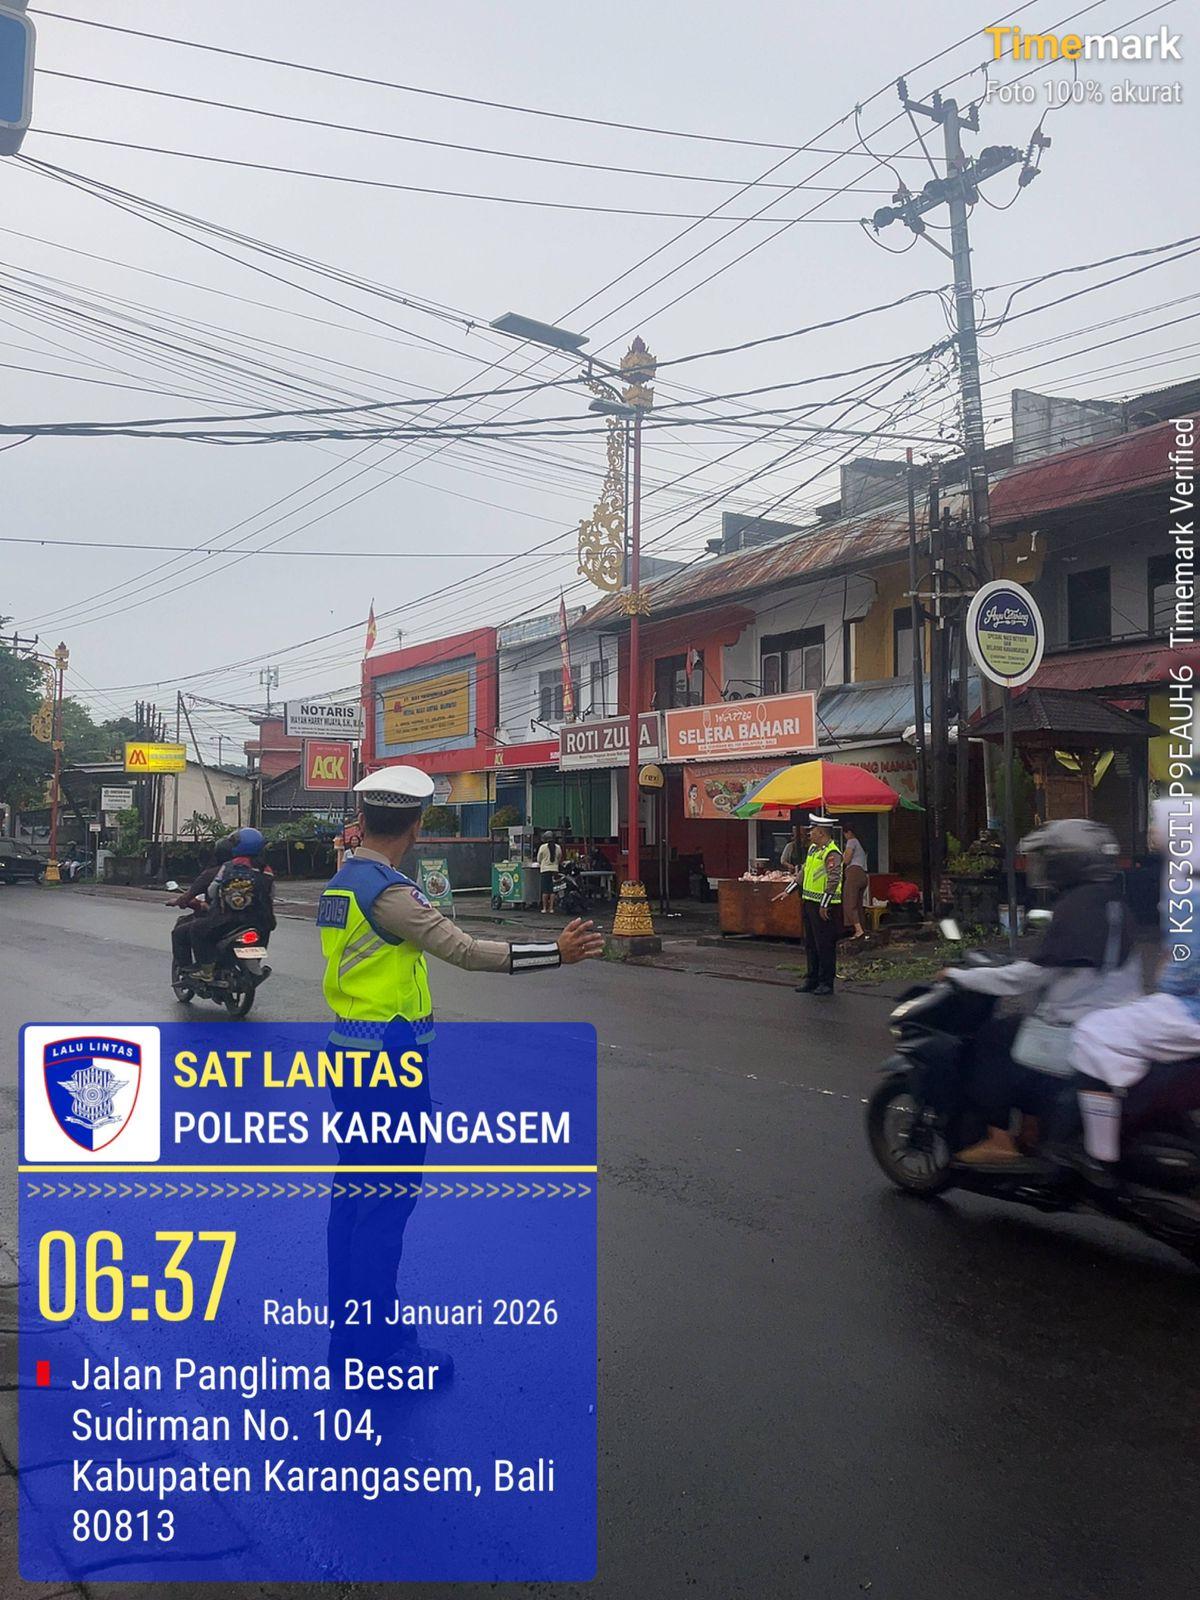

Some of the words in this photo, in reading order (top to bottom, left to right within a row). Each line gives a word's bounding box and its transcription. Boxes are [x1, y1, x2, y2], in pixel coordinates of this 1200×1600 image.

[300, 704, 354, 718] NOTARIS
[566, 729, 599, 753] ROTI
[602, 723, 652, 749] ZULA
[678, 724, 735, 745] SELERA
[738, 717, 801, 740] BAHARI
[311, 755, 345, 780] ACK
